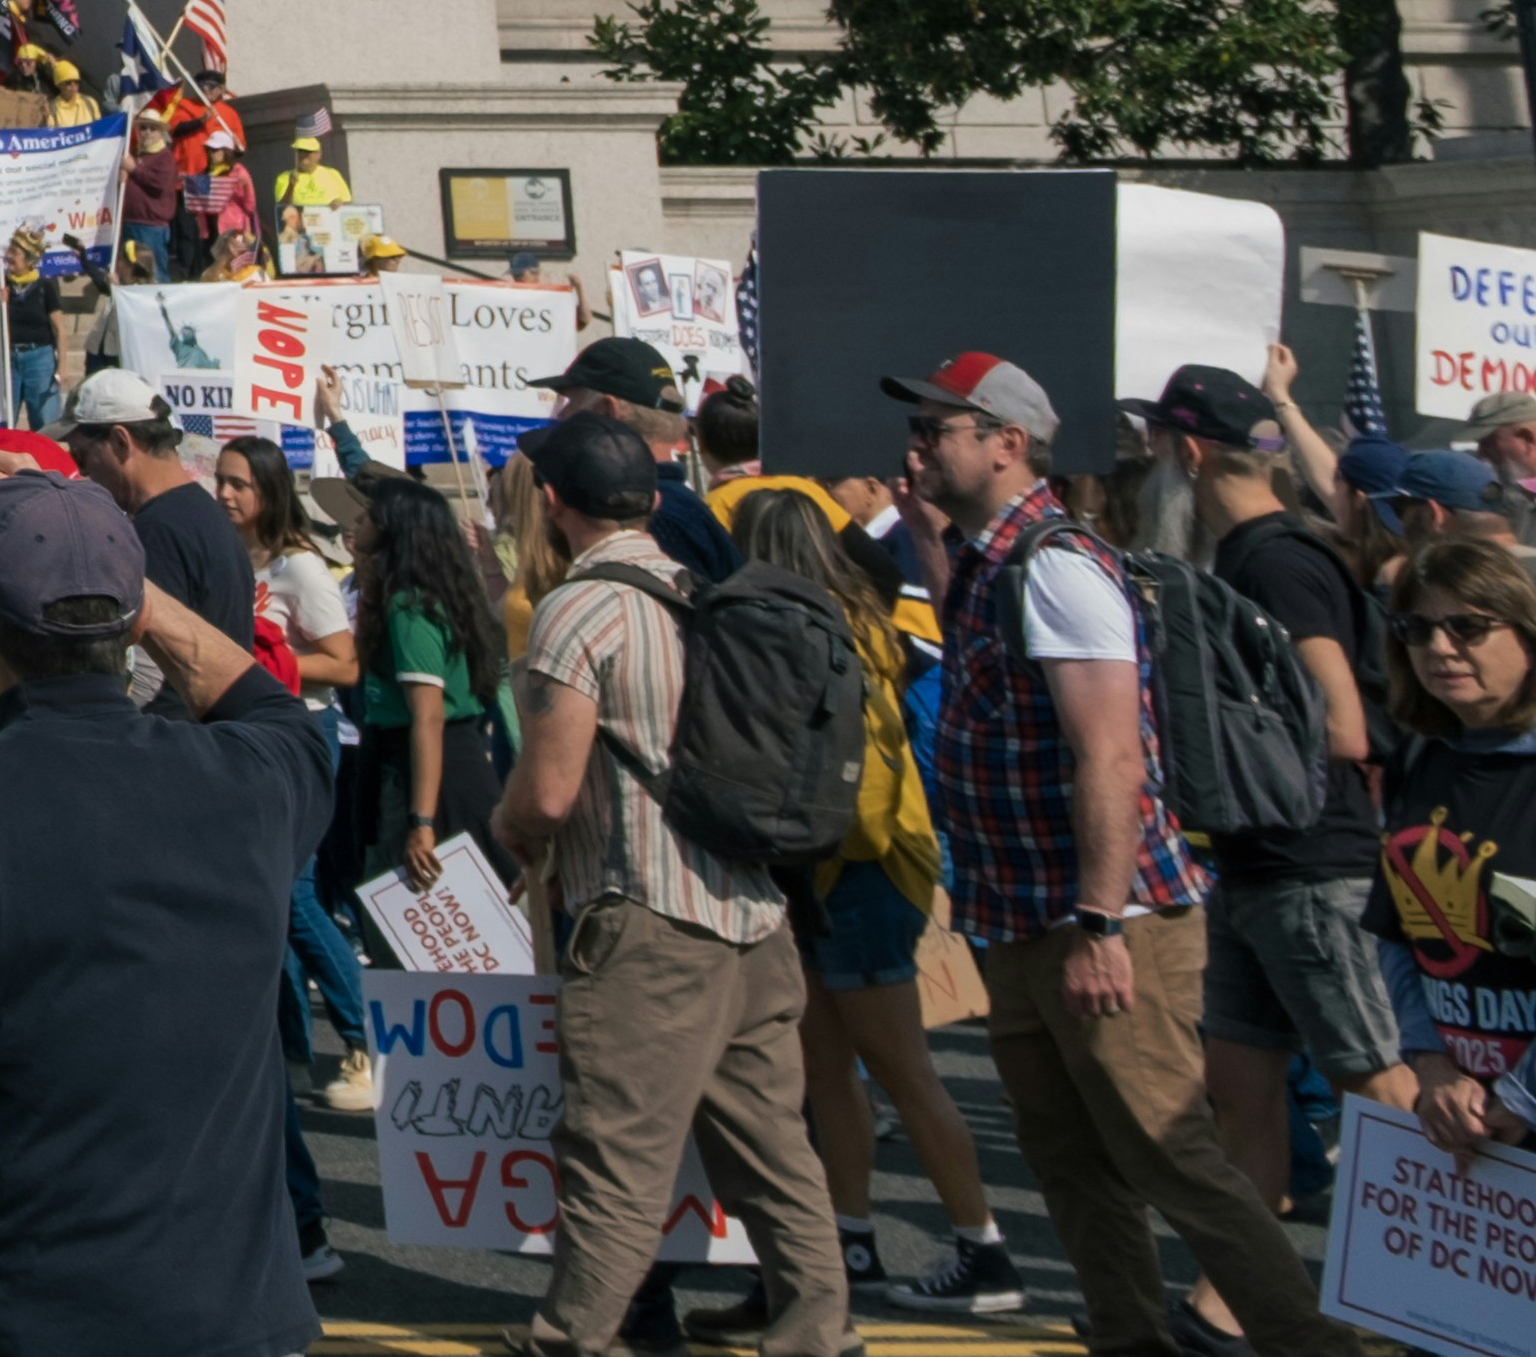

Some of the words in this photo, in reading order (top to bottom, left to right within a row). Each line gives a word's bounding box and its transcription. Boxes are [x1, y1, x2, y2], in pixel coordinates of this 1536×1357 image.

[7, 127, 92, 152] America!
[449, 292, 554, 333] Loves
[1449, 263, 1536, 315] DEFE
[251, 299, 309, 421] NOPE
[672, 325, 708, 347] DOES
[166, 384, 196, 410] NO
[1361, 1181, 1418, 1226] FOR
[1428, 1199, 1478, 1246] THE
[1393, 1155, 1536, 1227] STATEHOO
[1384, 1226, 1422, 1260] OF
[1430, 1238, 1471, 1279] DC
